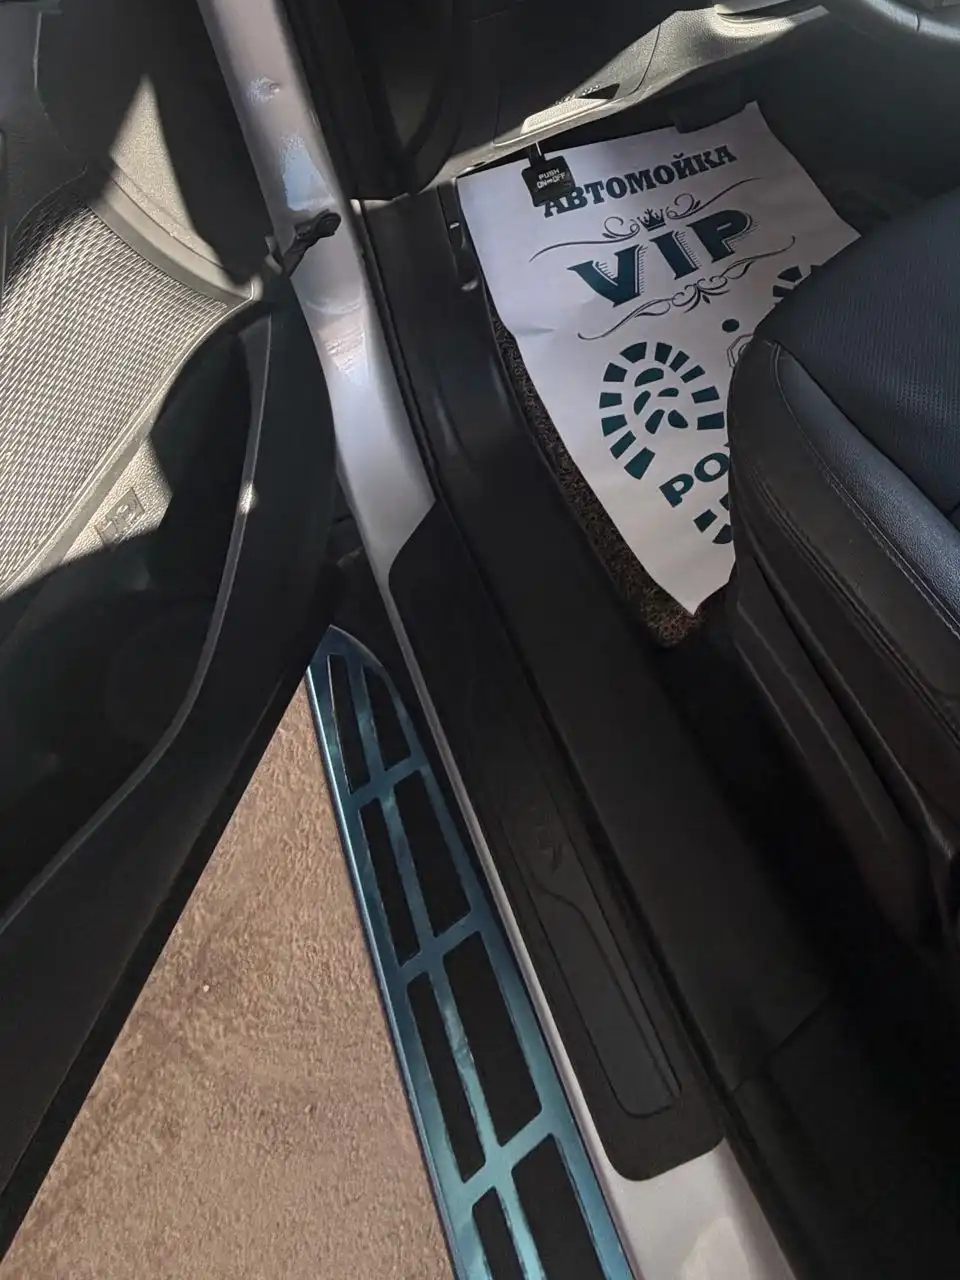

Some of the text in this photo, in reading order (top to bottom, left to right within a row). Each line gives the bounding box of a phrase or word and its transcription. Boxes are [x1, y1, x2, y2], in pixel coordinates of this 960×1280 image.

[538, 168, 560, 181] PUSH
[544, 145, 738, 218] АВТОМОЙКА
[567, 209, 755, 308] VIP
